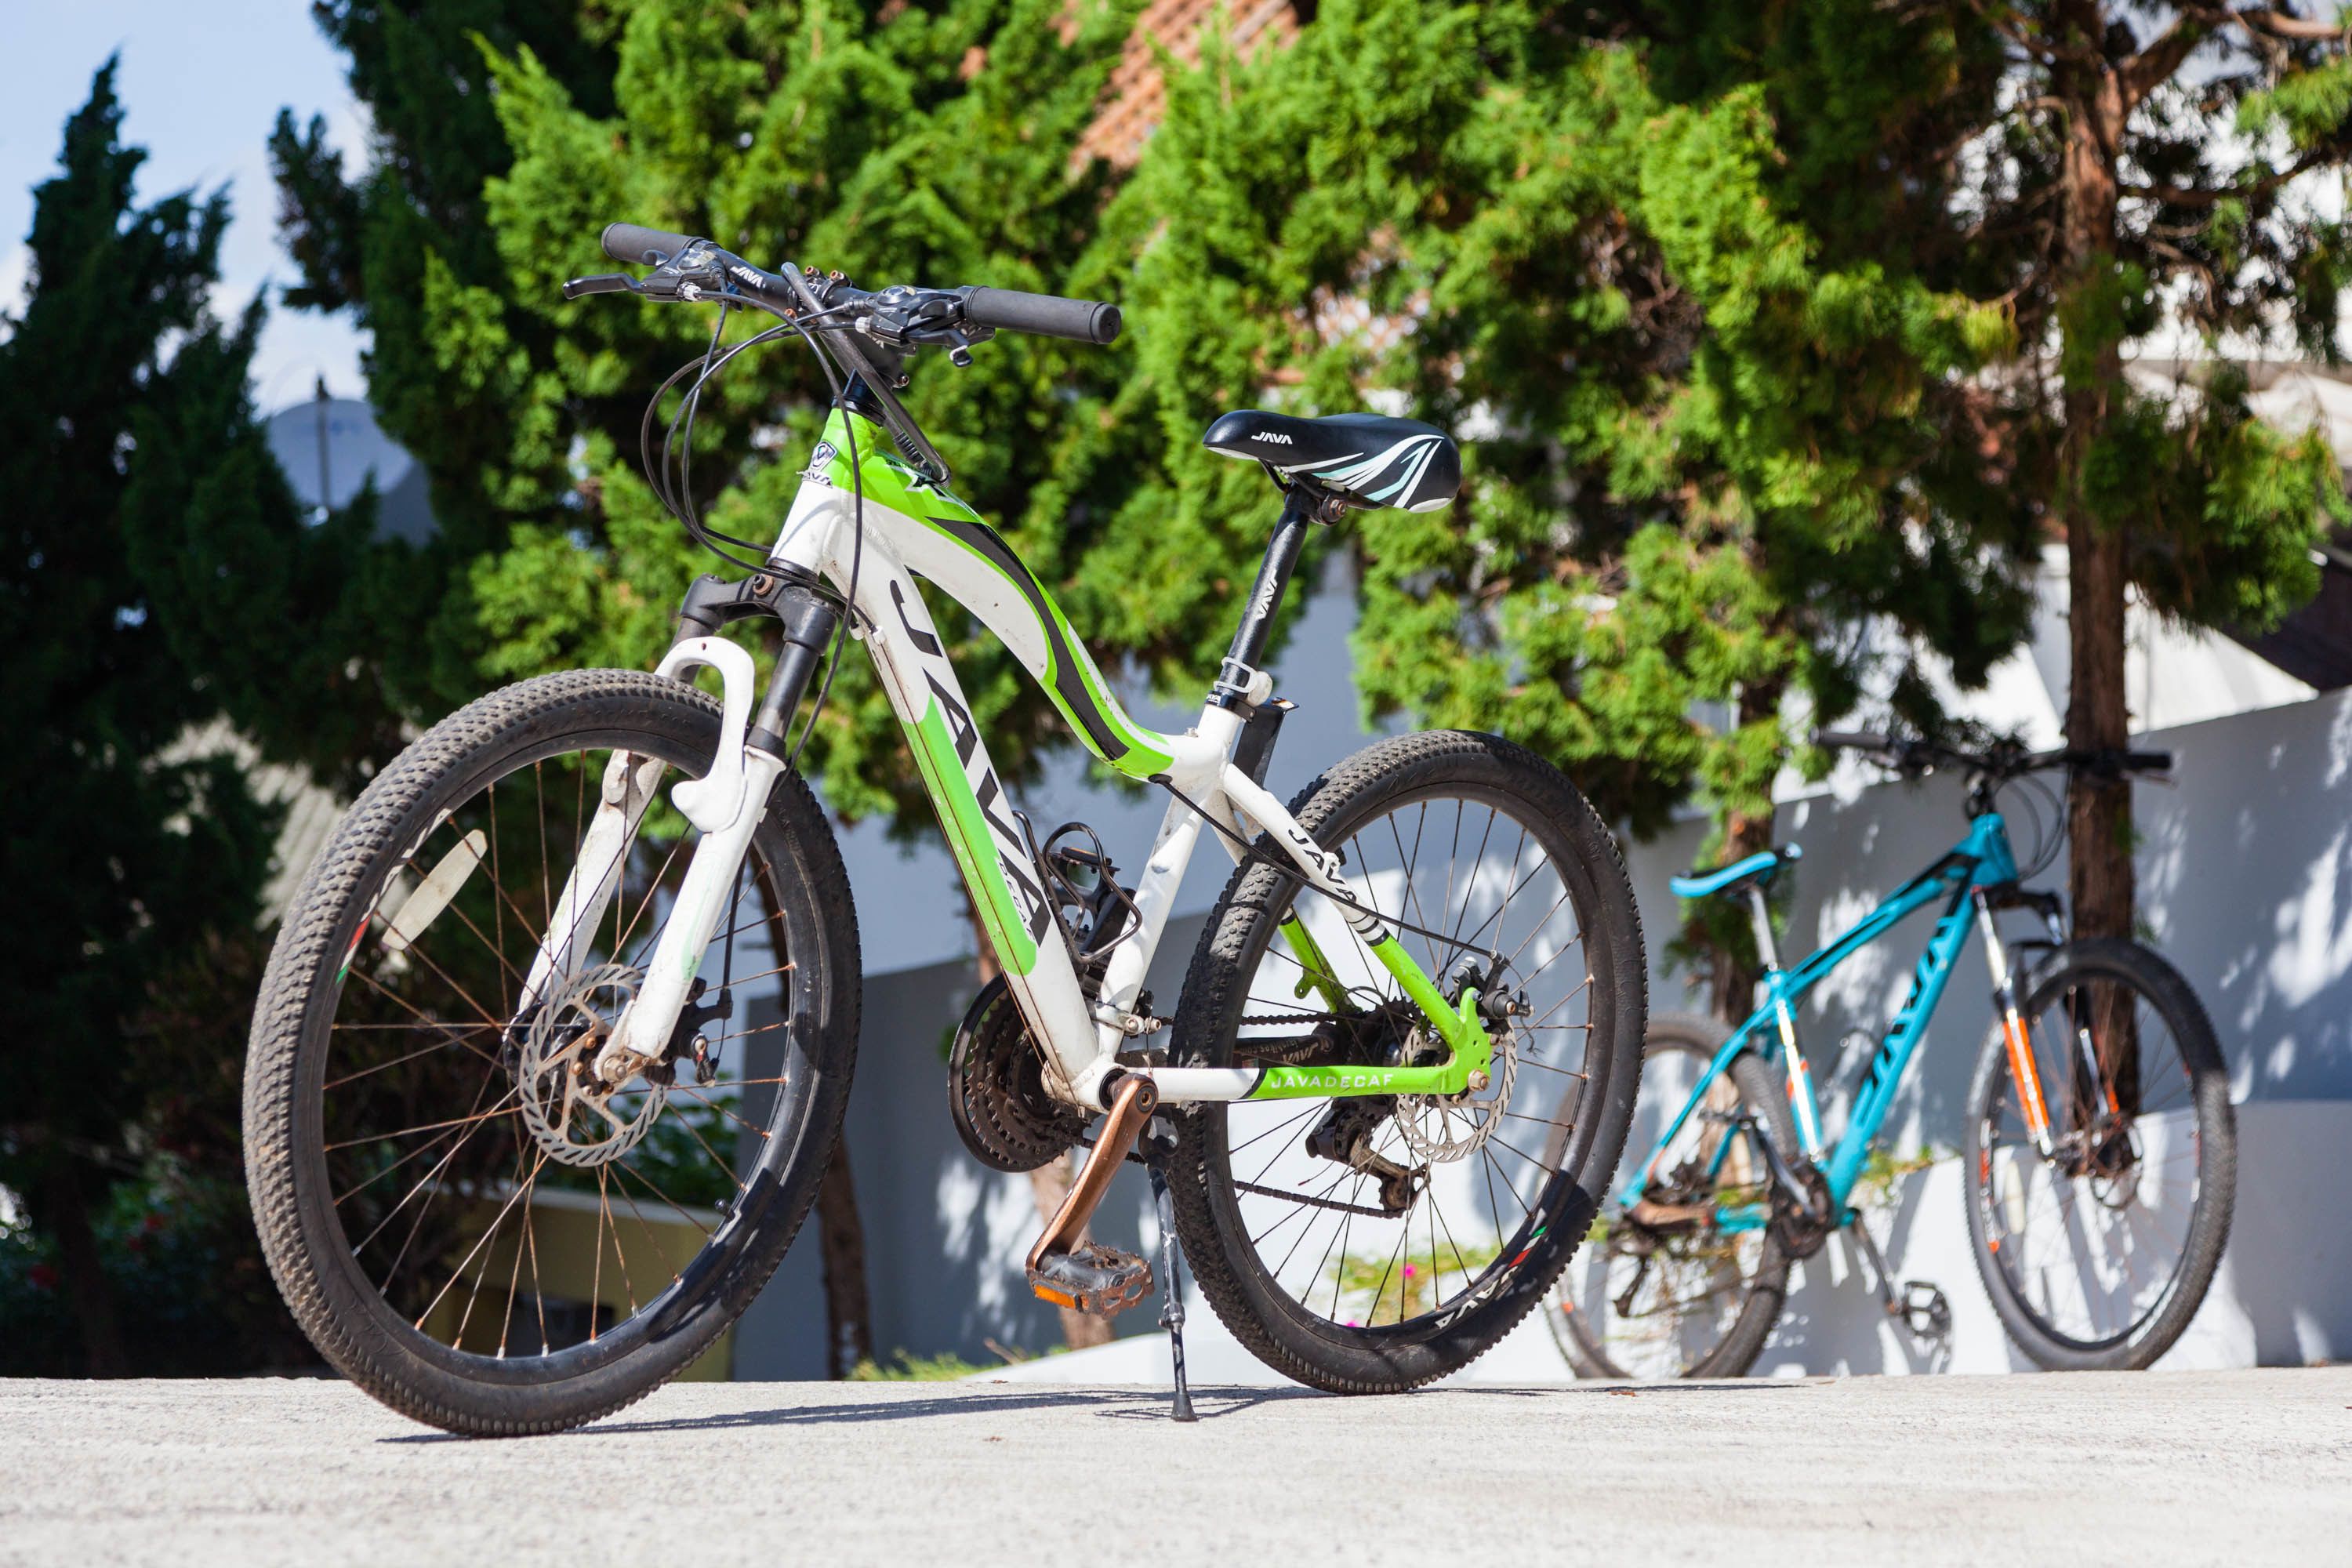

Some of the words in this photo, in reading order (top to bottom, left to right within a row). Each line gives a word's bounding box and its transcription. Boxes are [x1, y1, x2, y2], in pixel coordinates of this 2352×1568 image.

[730, 266, 764, 289] JAVA
[1250, 431, 1293, 445] JAVA
[1254, 575, 1278, 620] JAVA
[890, 579, 1051, 948] JAVA
[1288, 829, 1357, 903] JAVA
[1000, 862, 1036, 941] DECAF
[1435, 1265, 1518, 1329] JAVA
